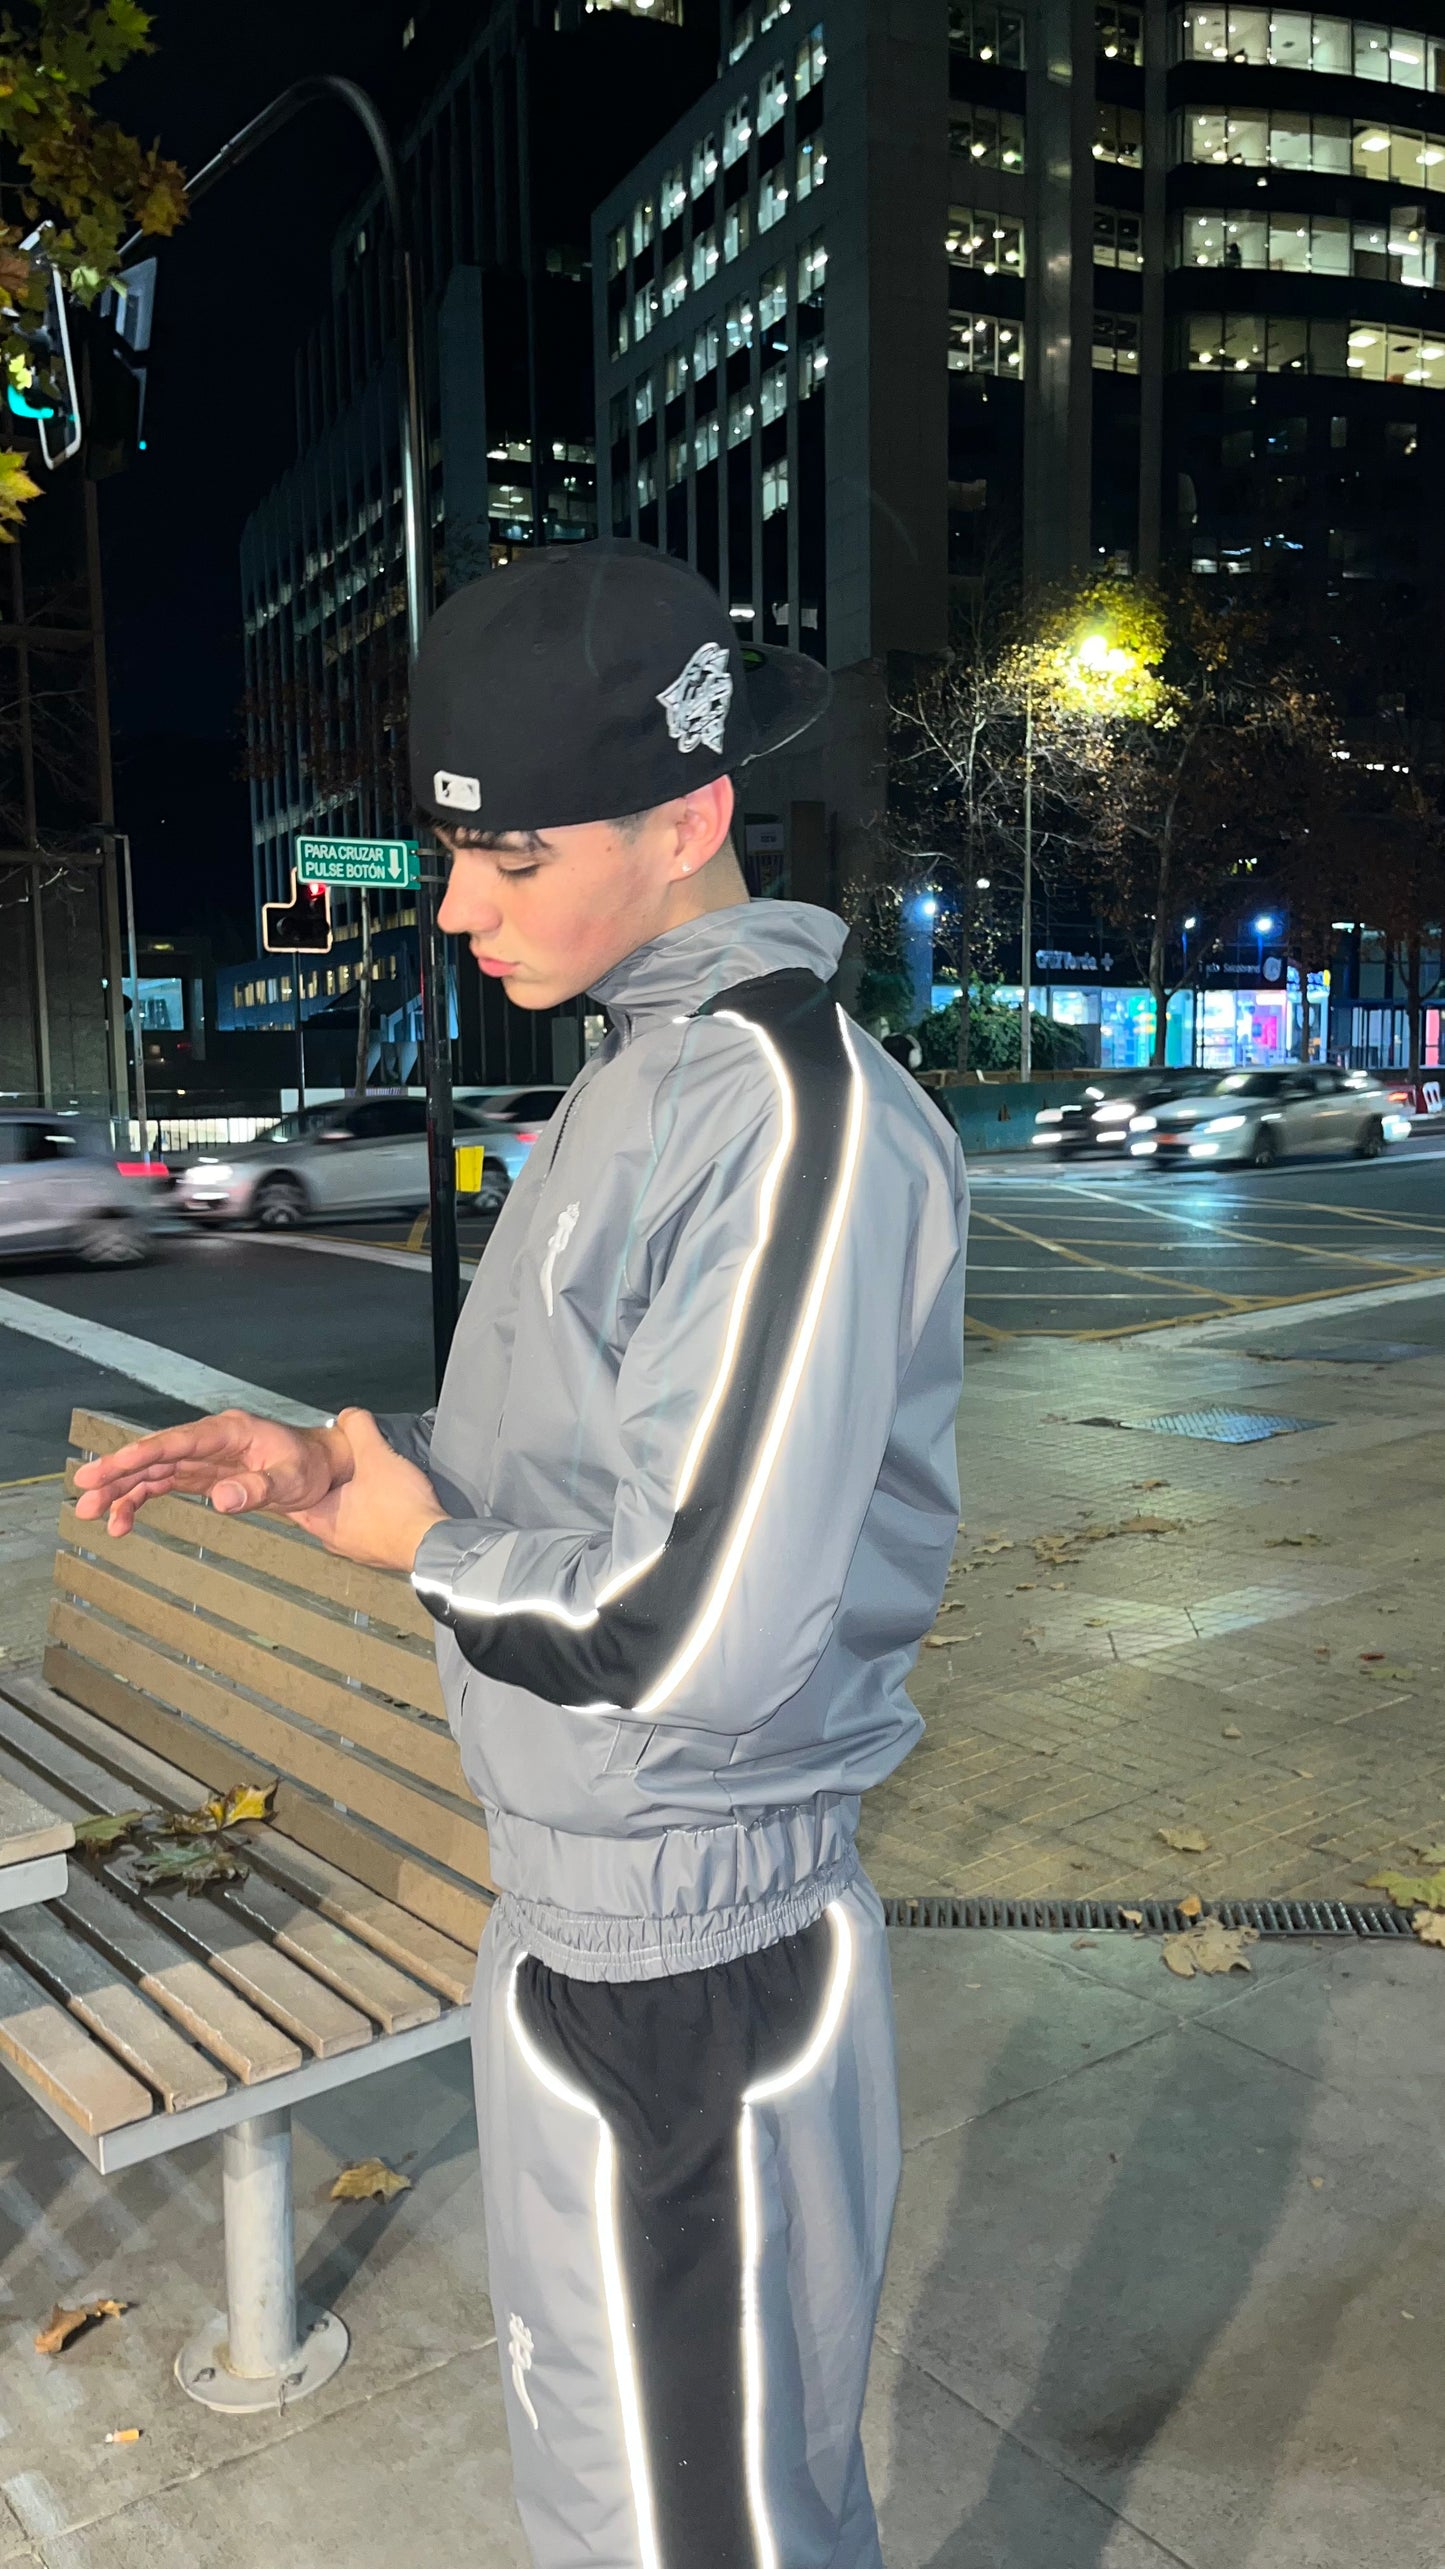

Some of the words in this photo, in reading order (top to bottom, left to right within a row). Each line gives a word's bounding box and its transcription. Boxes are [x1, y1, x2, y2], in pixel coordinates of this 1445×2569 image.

[304, 843, 338, 860] PARA
[338, 846, 384, 862] CRUZAR
[305, 861, 344, 878] PULSE
[346, 862, 386, 880] BOTÓN
